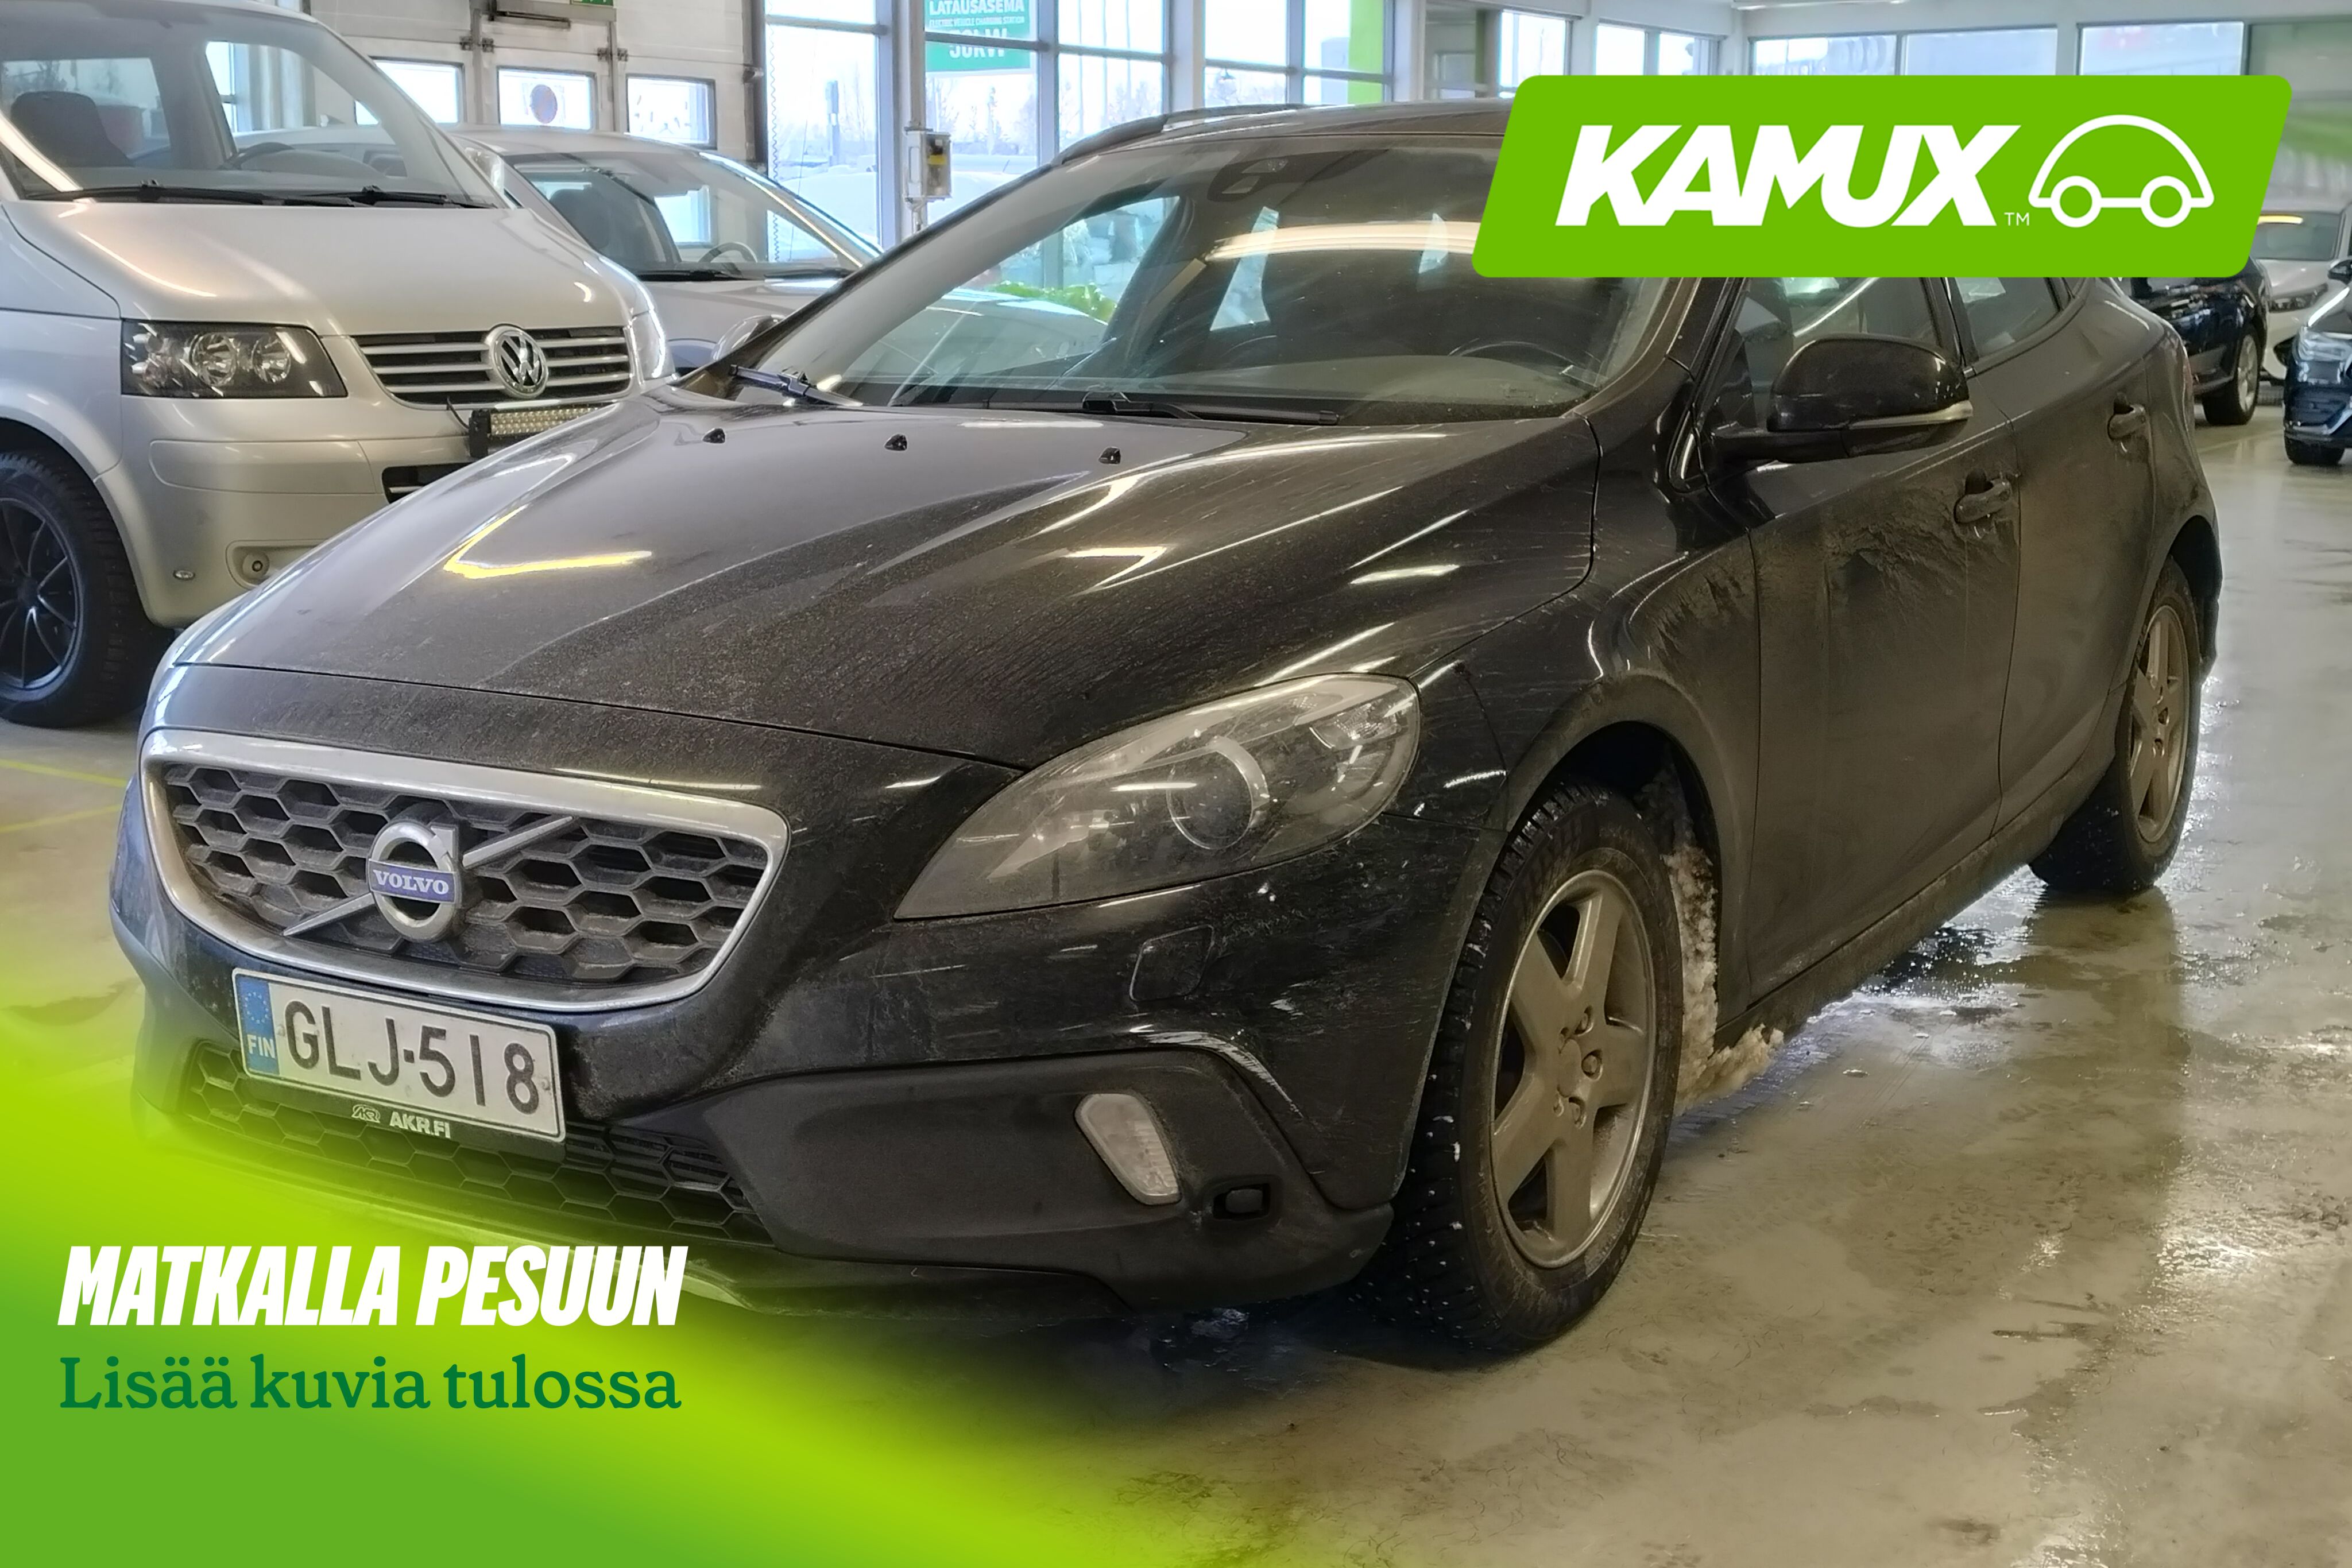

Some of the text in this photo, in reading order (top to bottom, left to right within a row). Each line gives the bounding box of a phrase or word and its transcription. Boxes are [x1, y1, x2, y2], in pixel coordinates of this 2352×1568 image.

[373, 869, 449, 895] VOLVO
[247, 1033, 276, 1059] FIN
[284, 1000, 540, 1116] GLJ-518
[389, 1111, 451, 1139] AKR.FI
